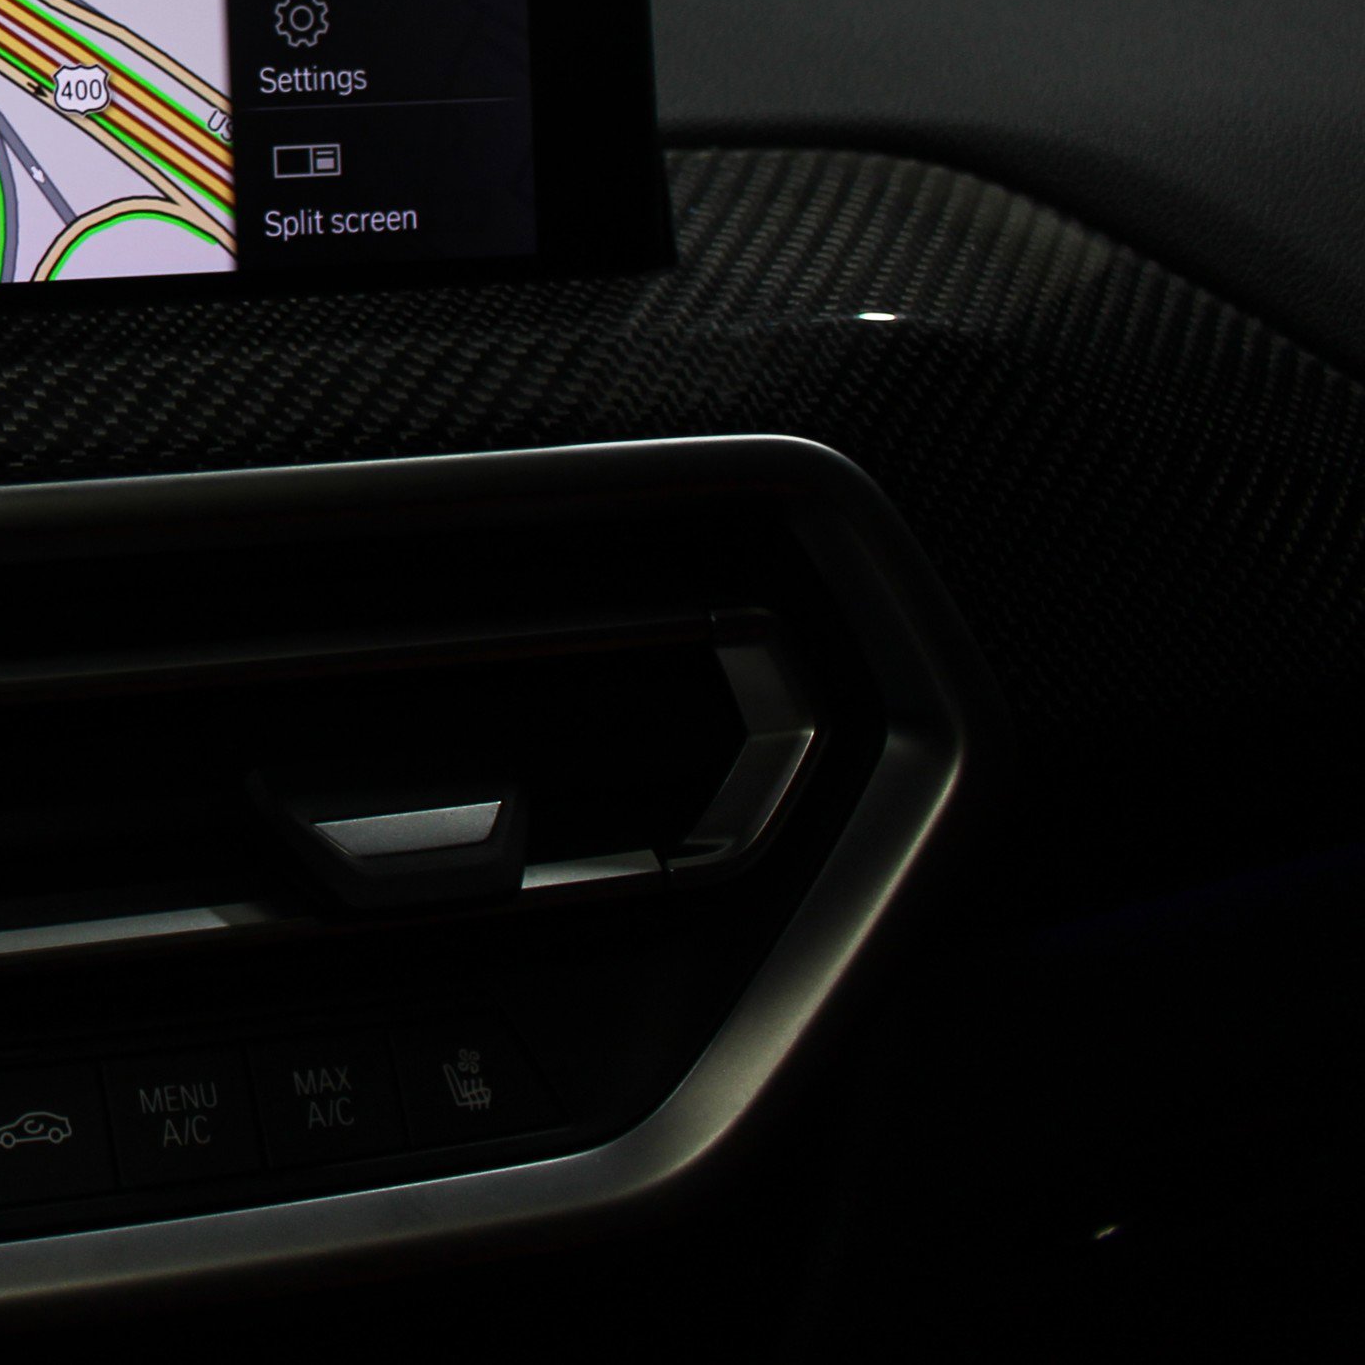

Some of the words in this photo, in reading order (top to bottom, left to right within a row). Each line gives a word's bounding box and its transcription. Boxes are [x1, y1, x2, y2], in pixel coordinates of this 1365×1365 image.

[60, 79, 103, 102] 400
[260, 65, 368, 96] Settings
[265, 209, 324, 243] Split
[331, 206, 418, 233] screen
[292, 1066, 354, 1096] MAX
[139, 1082, 218, 1115] MENU
[307, 1098, 355, 1129] A/C
[162, 1118, 211, 1148] A/C
